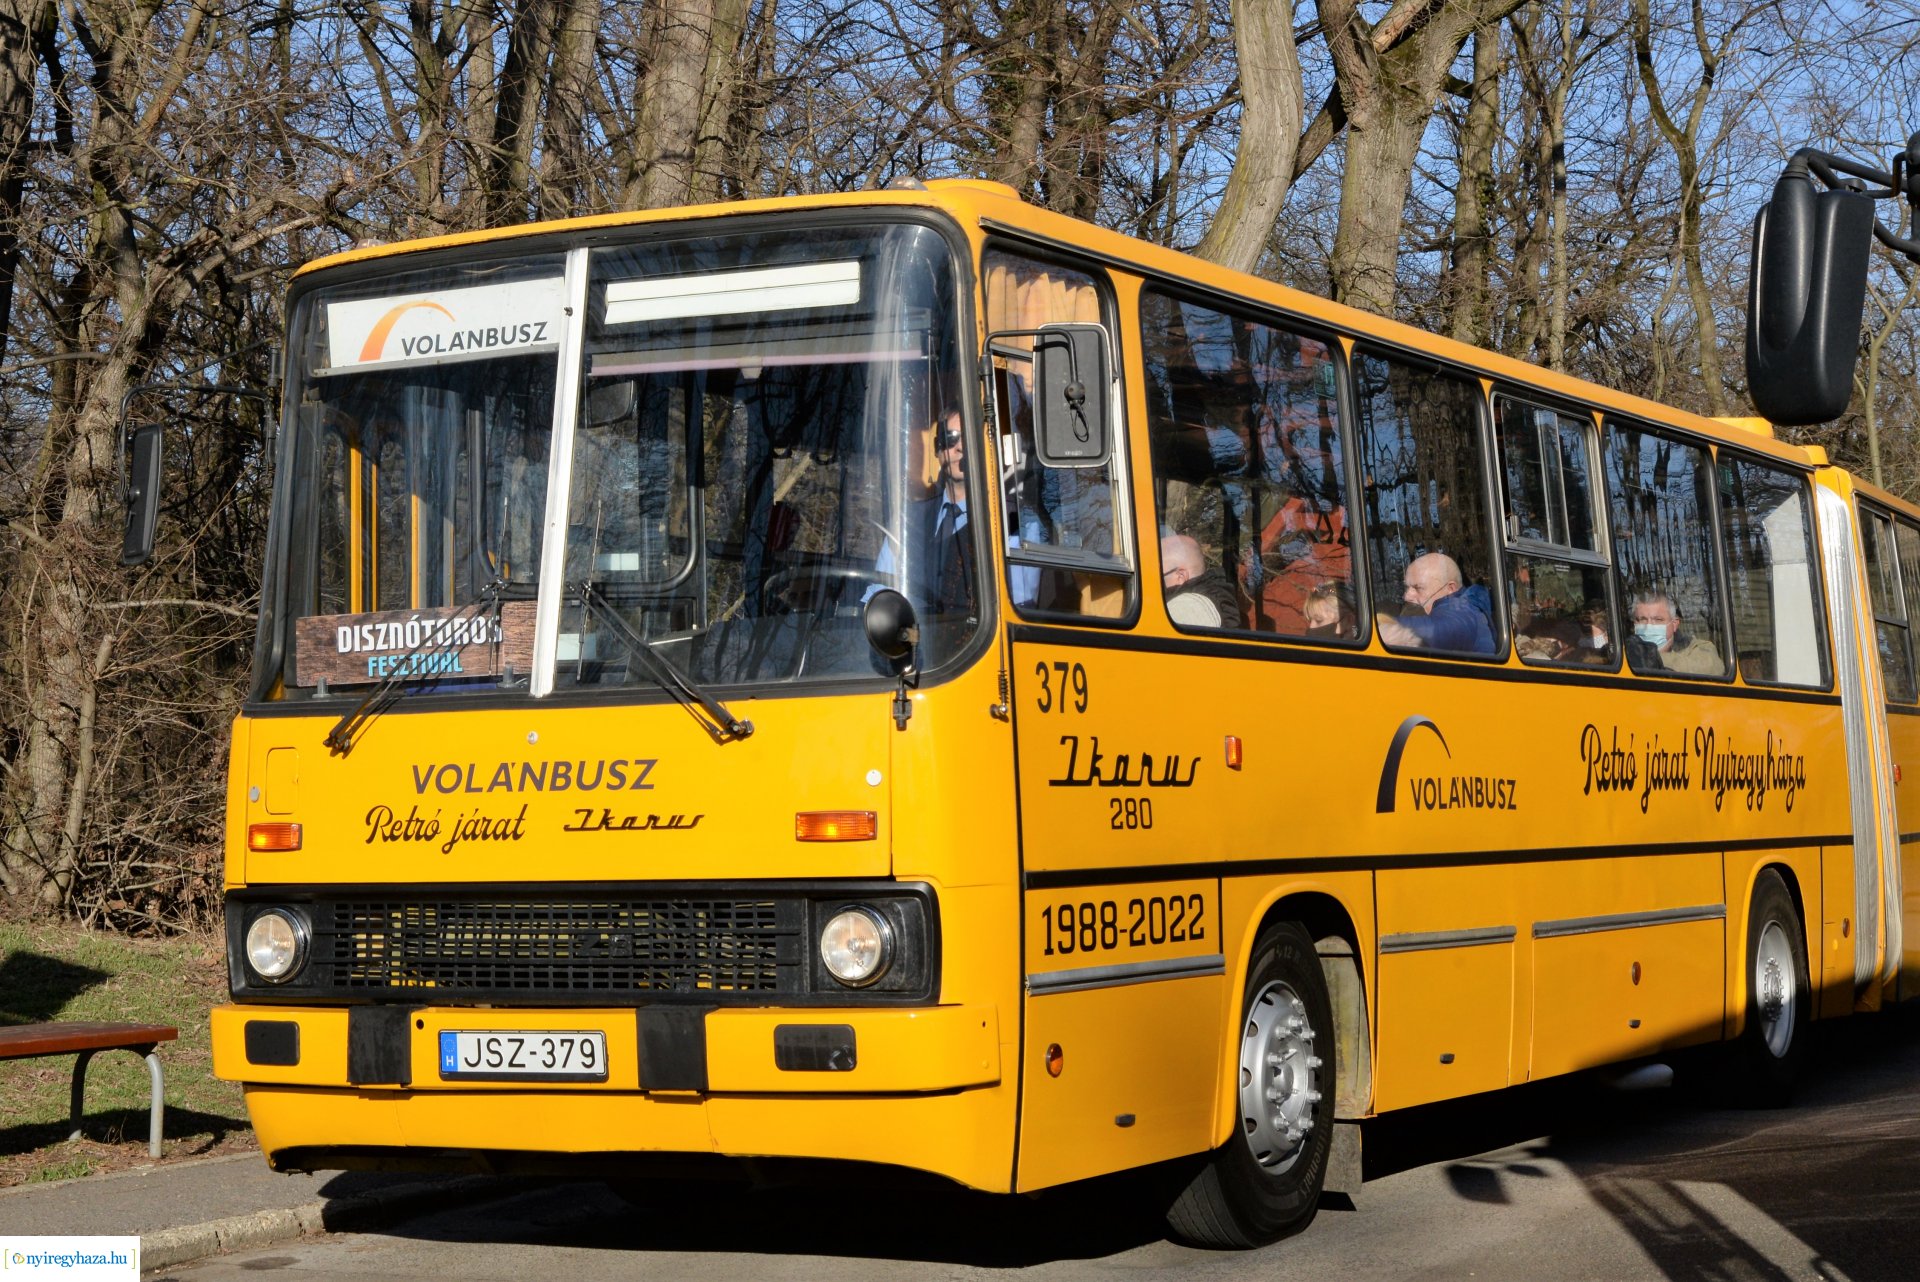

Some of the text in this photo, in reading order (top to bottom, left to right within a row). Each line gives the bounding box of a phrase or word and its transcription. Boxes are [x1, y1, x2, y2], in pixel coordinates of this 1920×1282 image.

[401, 321, 548, 356] VOLÁNBUSZ
[1035, 661, 1089, 714] 379
[412, 758, 659, 794] VOLÁNBUSZ
[1048, 735, 1201, 787] Ikarus
[1580, 723, 1807, 814] Retró járat Nyíregyháza
[1410, 776, 1517, 811] VOLÁNBUSZ
[365, 804, 529, 855] Retró járat
[563, 808, 704, 832] Ikarus
[1110, 798, 1153, 830] 280
[1042, 893, 1204, 955] 1988-2022
[446, 1055, 454, 1067] H
[464, 1038, 596, 1069] JSZ-379
